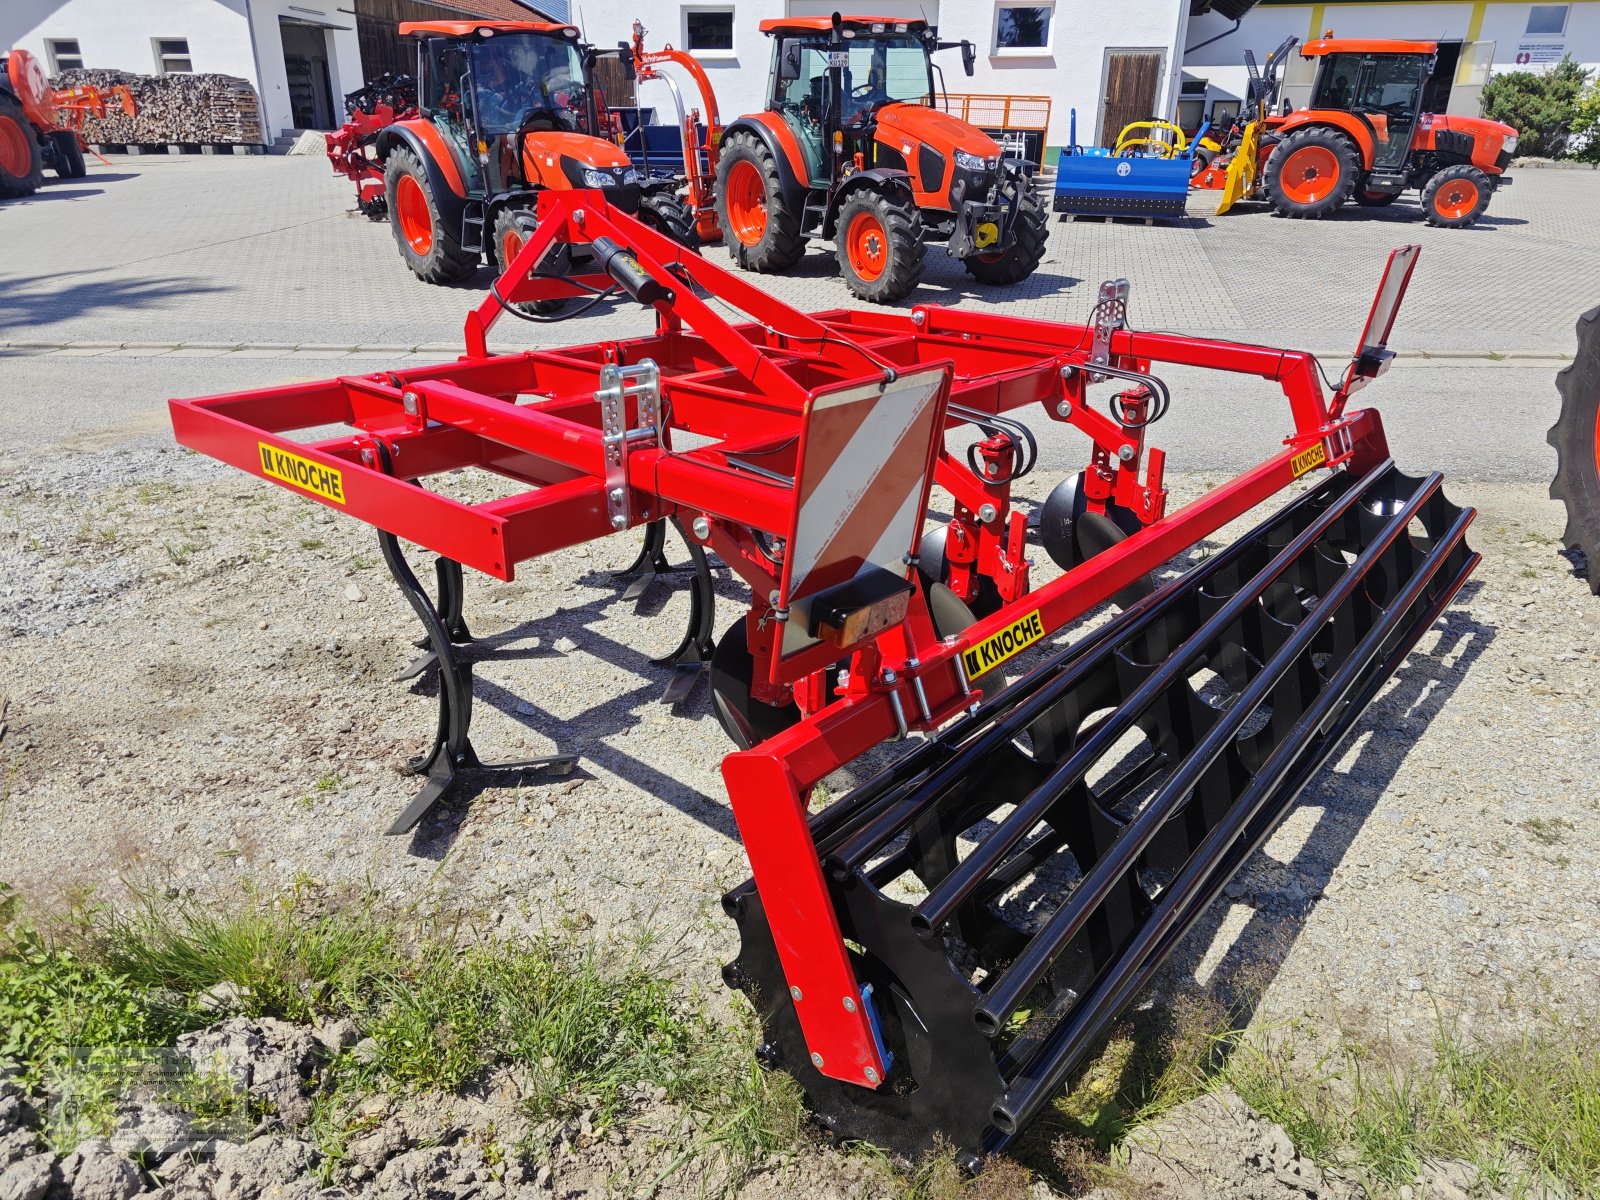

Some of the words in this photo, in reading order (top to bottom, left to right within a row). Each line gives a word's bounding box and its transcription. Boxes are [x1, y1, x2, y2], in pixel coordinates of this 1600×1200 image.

[275, 452, 342, 499] KNOCHE
[1297, 445, 1324, 471] KNOCHE
[980, 613, 1042, 667] KNOCHE
